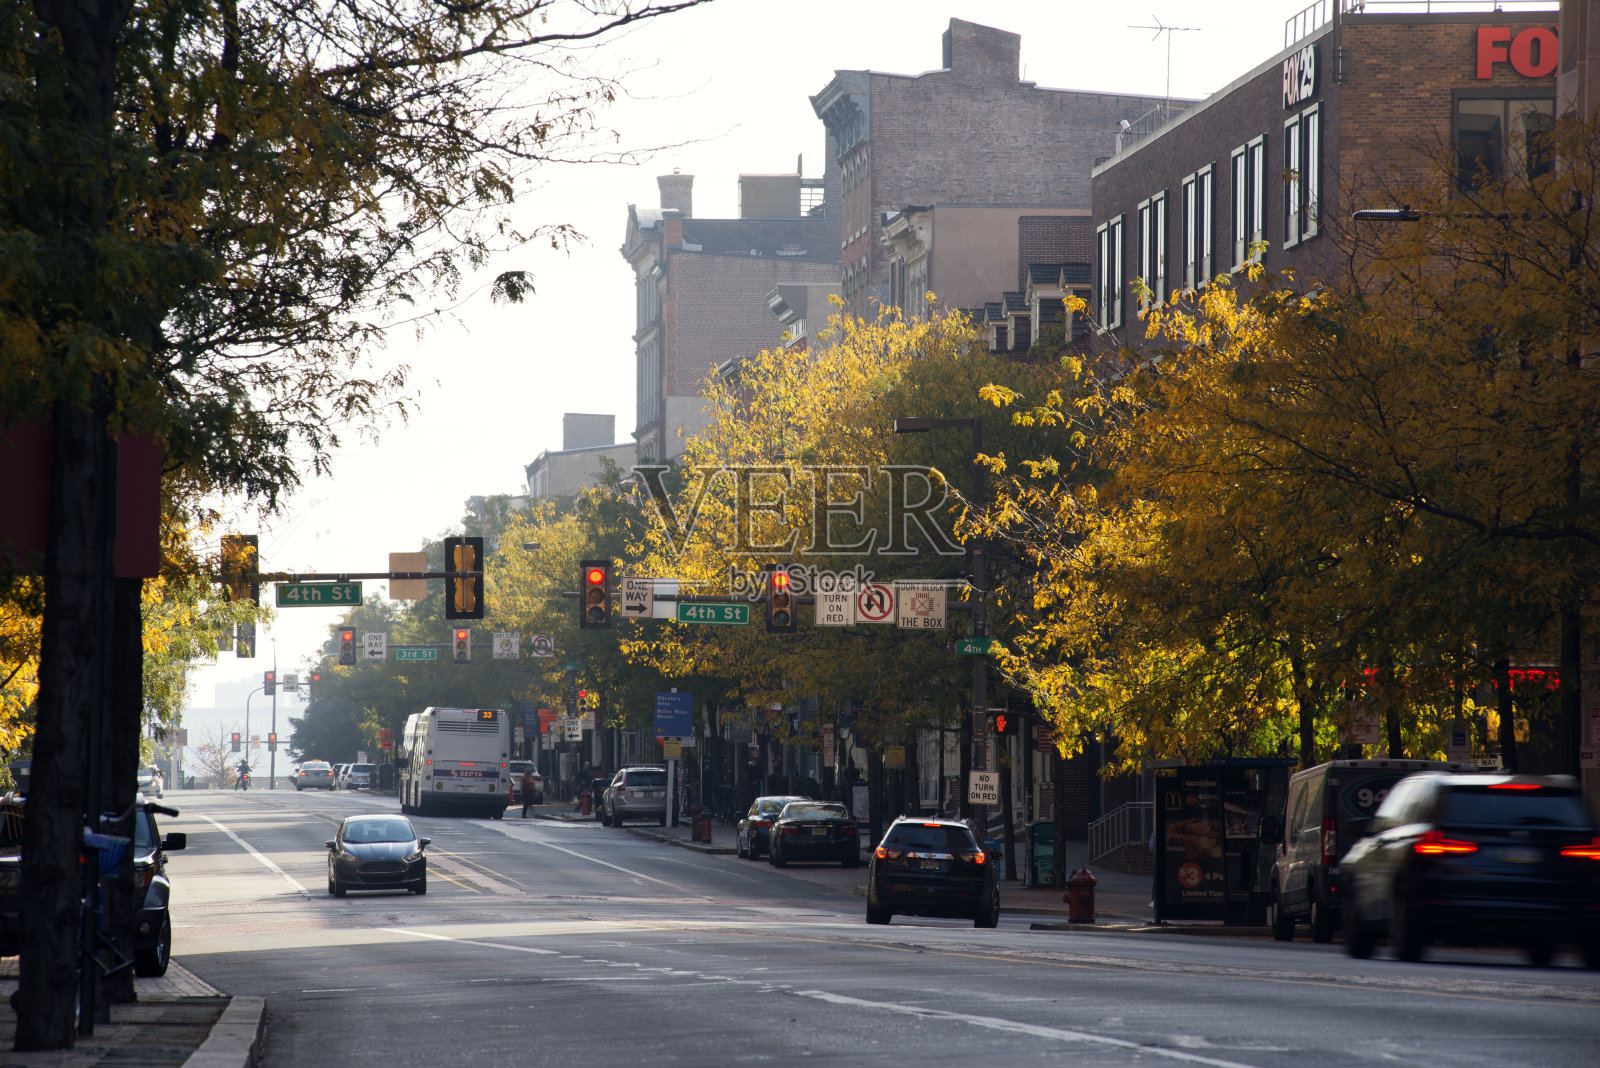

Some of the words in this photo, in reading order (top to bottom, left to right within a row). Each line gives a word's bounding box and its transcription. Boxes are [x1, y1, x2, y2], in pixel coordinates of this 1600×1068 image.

[1476, 27, 1559, 79] FO
[1283, 51, 1301, 110] FOX
[1300, 44, 1315, 100] 29
[625, 581, 649, 592] ONE
[825, 581, 846, 592] NO
[922, 582, 945, 592] BLOCK
[286, 587, 322, 601] 4th
[331, 586, 352, 600] St
[625, 591, 649, 602] WAY
[823, 594, 848, 603] TURN
[685, 606, 720, 620] 4th
[723, 604, 742, 619] St
[828, 604, 842, 612] ON
[826, 614, 844, 622] RED
[902, 617, 919, 627] THE
[923, 618, 943, 628] BOX
[963, 644, 982, 653] 4TH
[401, 650, 417, 658] 3rd
[422, 650, 433, 658] St
[482, 711, 492, 719] 33
[1481, 759, 1497, 767] WAY
[974, 783, 995, 791] TURN
[970, 792, 980, 800] ON
[982, 793, 997, 801] RED
